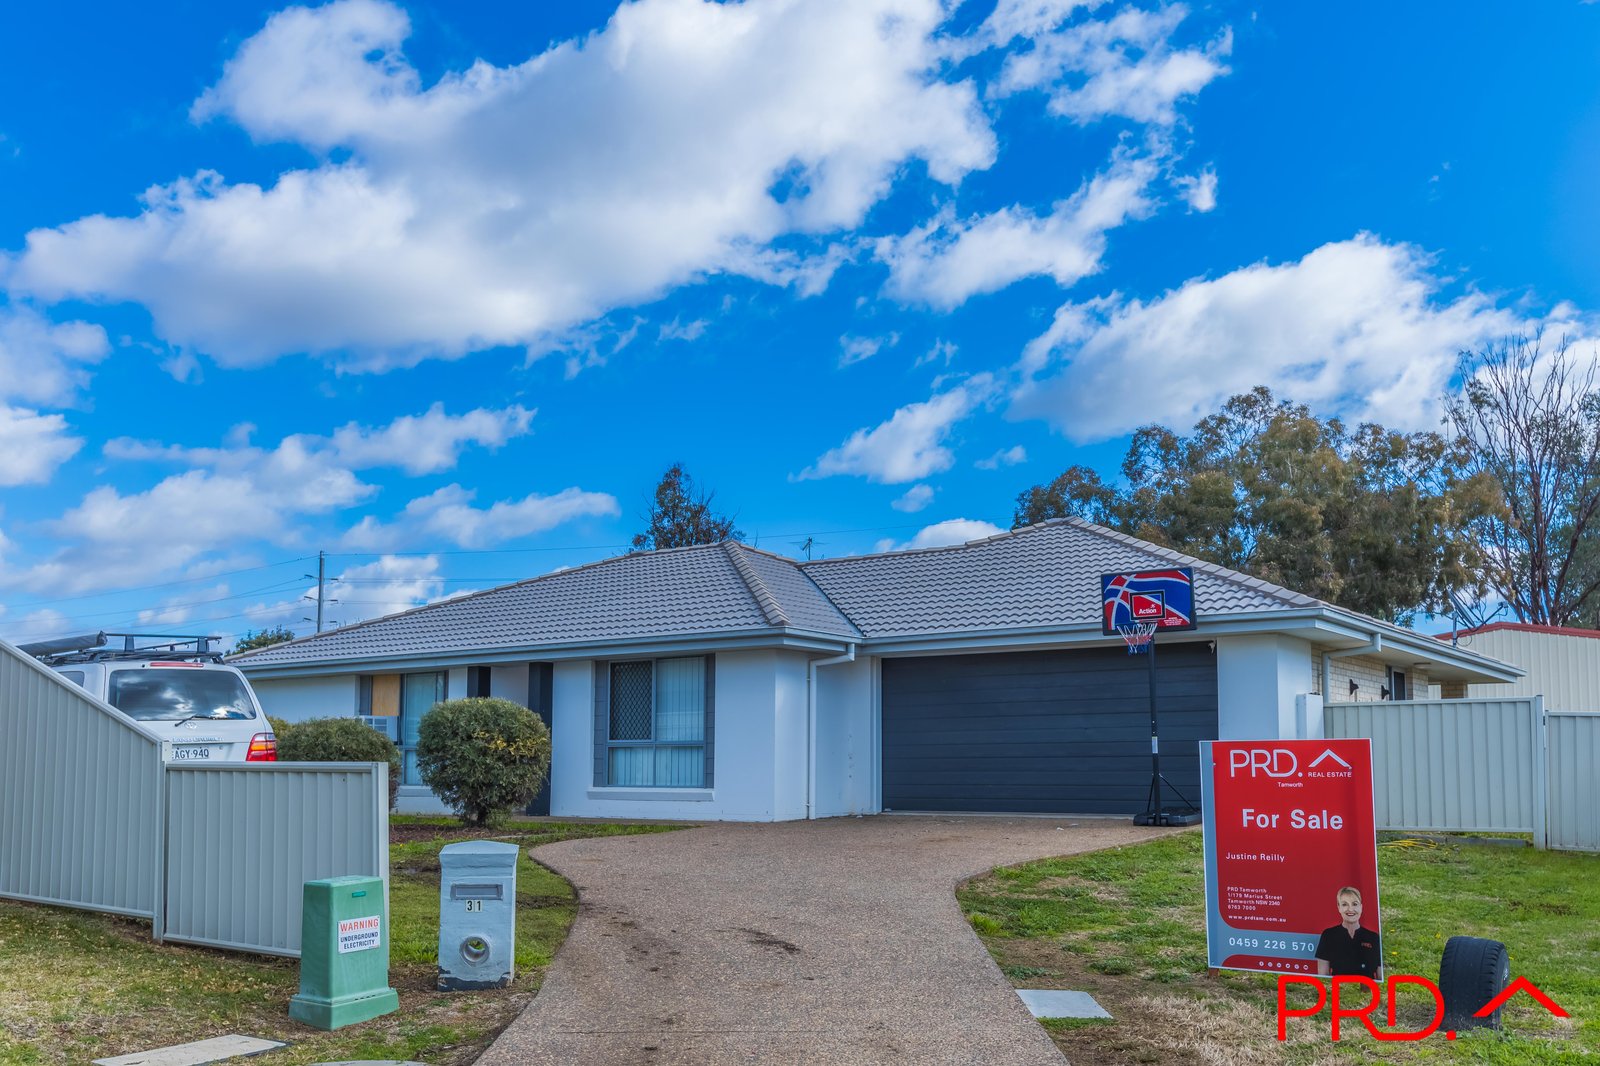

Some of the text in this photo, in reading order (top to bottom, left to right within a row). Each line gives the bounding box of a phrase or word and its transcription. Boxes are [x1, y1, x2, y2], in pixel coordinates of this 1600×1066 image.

[1229, 749, 1303, 778] PRD.
[1242, 808, 1343, 830] For Sale
[1226, 852, 1285, 862] Justine Reilly
[467, 900, 481, 911] 31
[340, 918, 379, 932] WARNING
[340, 931, 379, 943] UNDERGROUND
[343, 939, 376, 950] ELECTRICITY
[1229, 937, 1315, 952] 0459 226 570
